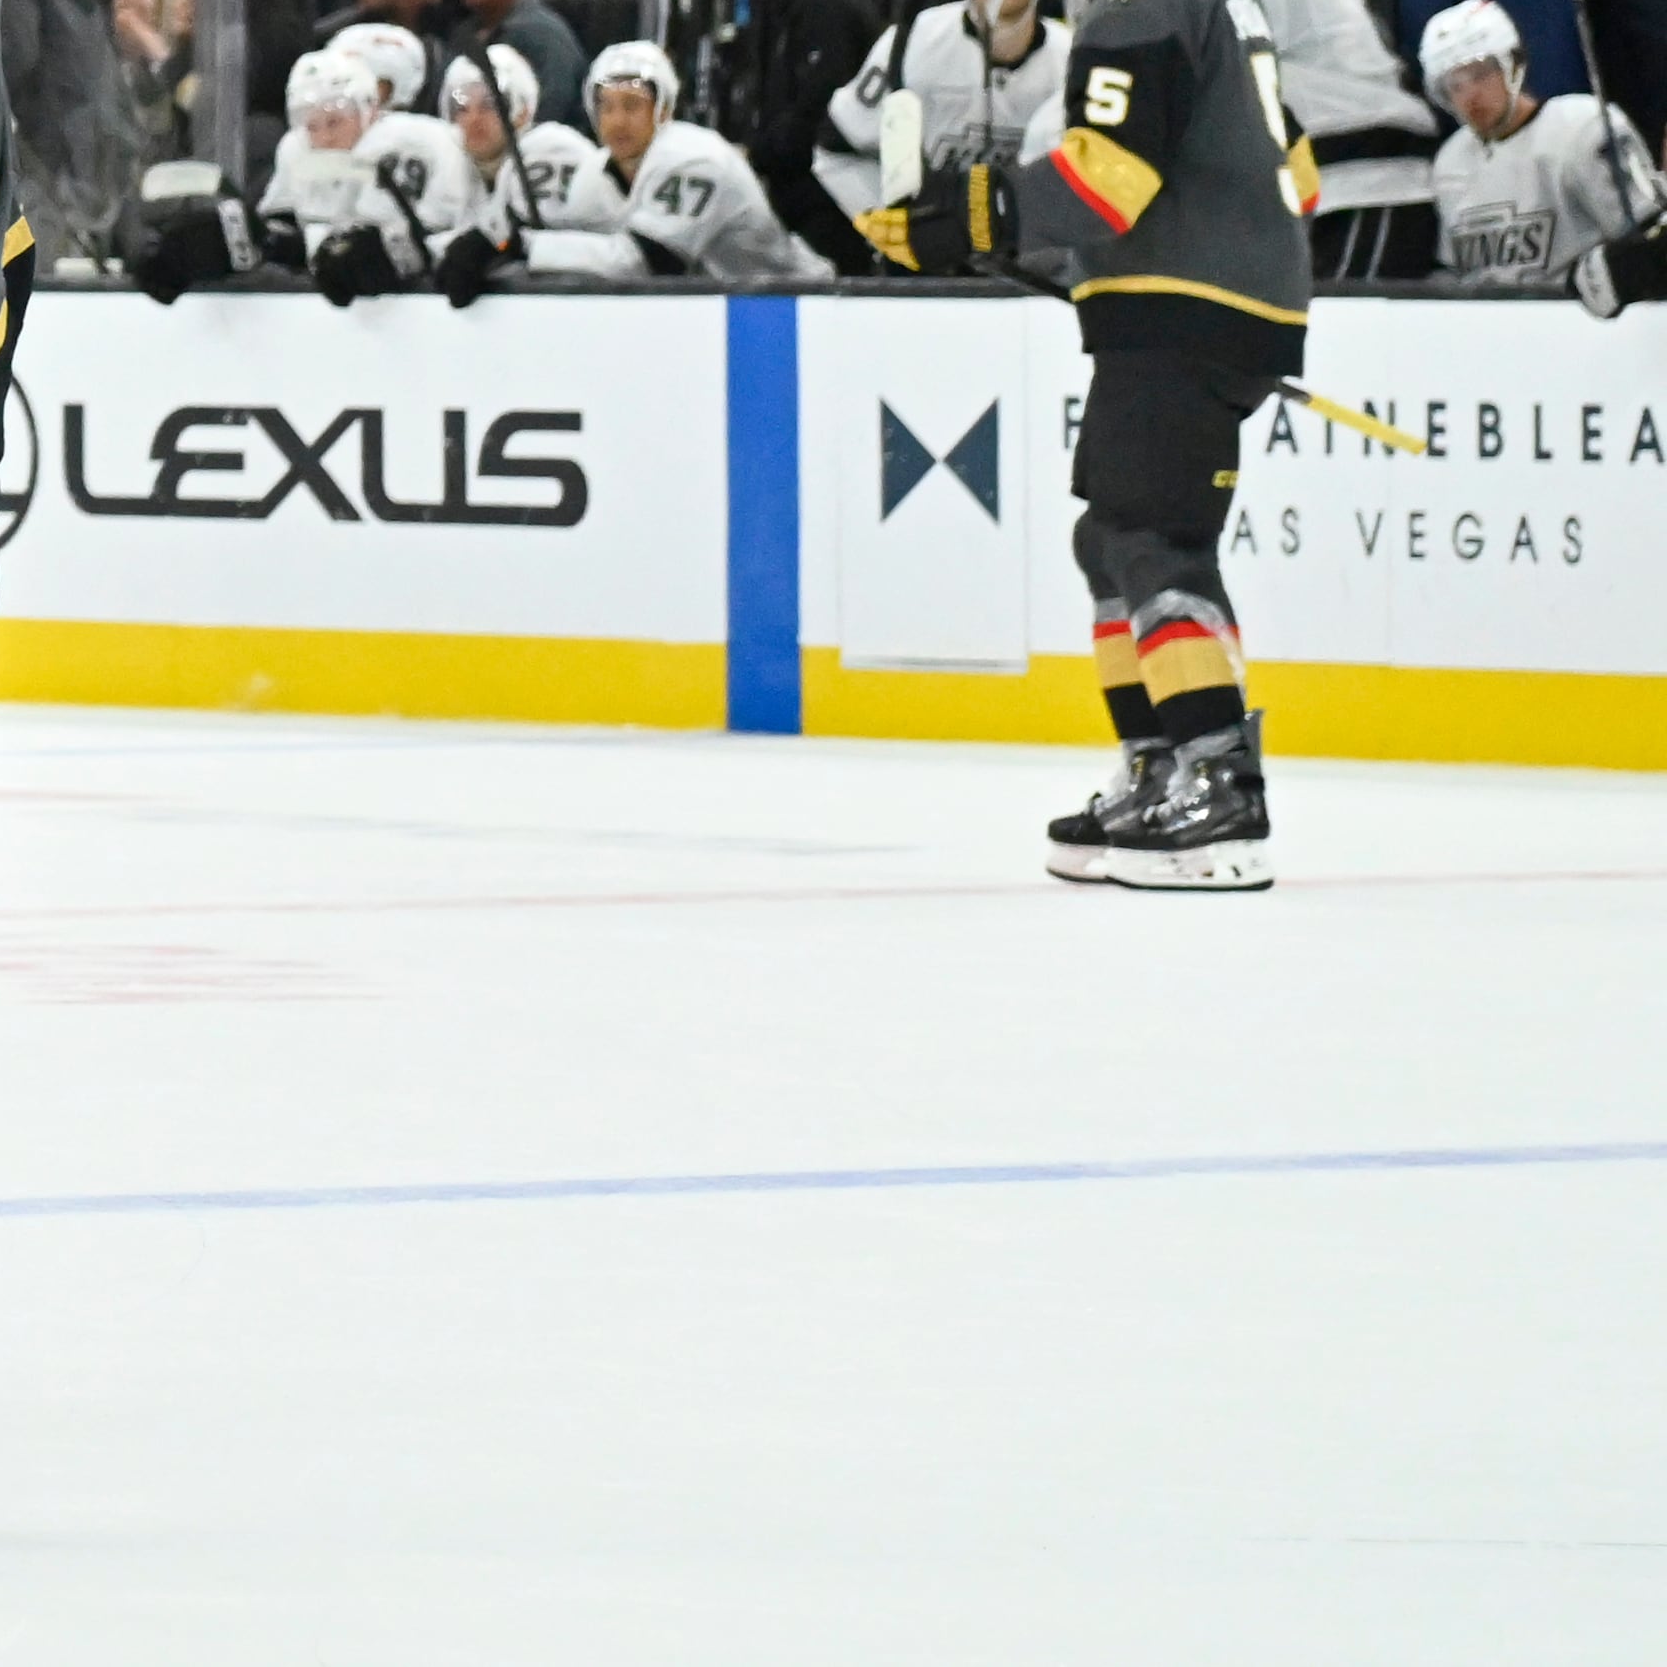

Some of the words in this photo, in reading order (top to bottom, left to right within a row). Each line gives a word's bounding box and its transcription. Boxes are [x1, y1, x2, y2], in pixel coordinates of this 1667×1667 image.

[1084, 66, 1133, 126] 5
[654, 175, 717, 217] 47
[64, 405, 588, 527] LEXUS
[1229, 507, 1302, 558] AS
[1356, 510, 1584, 565] VEGAS
